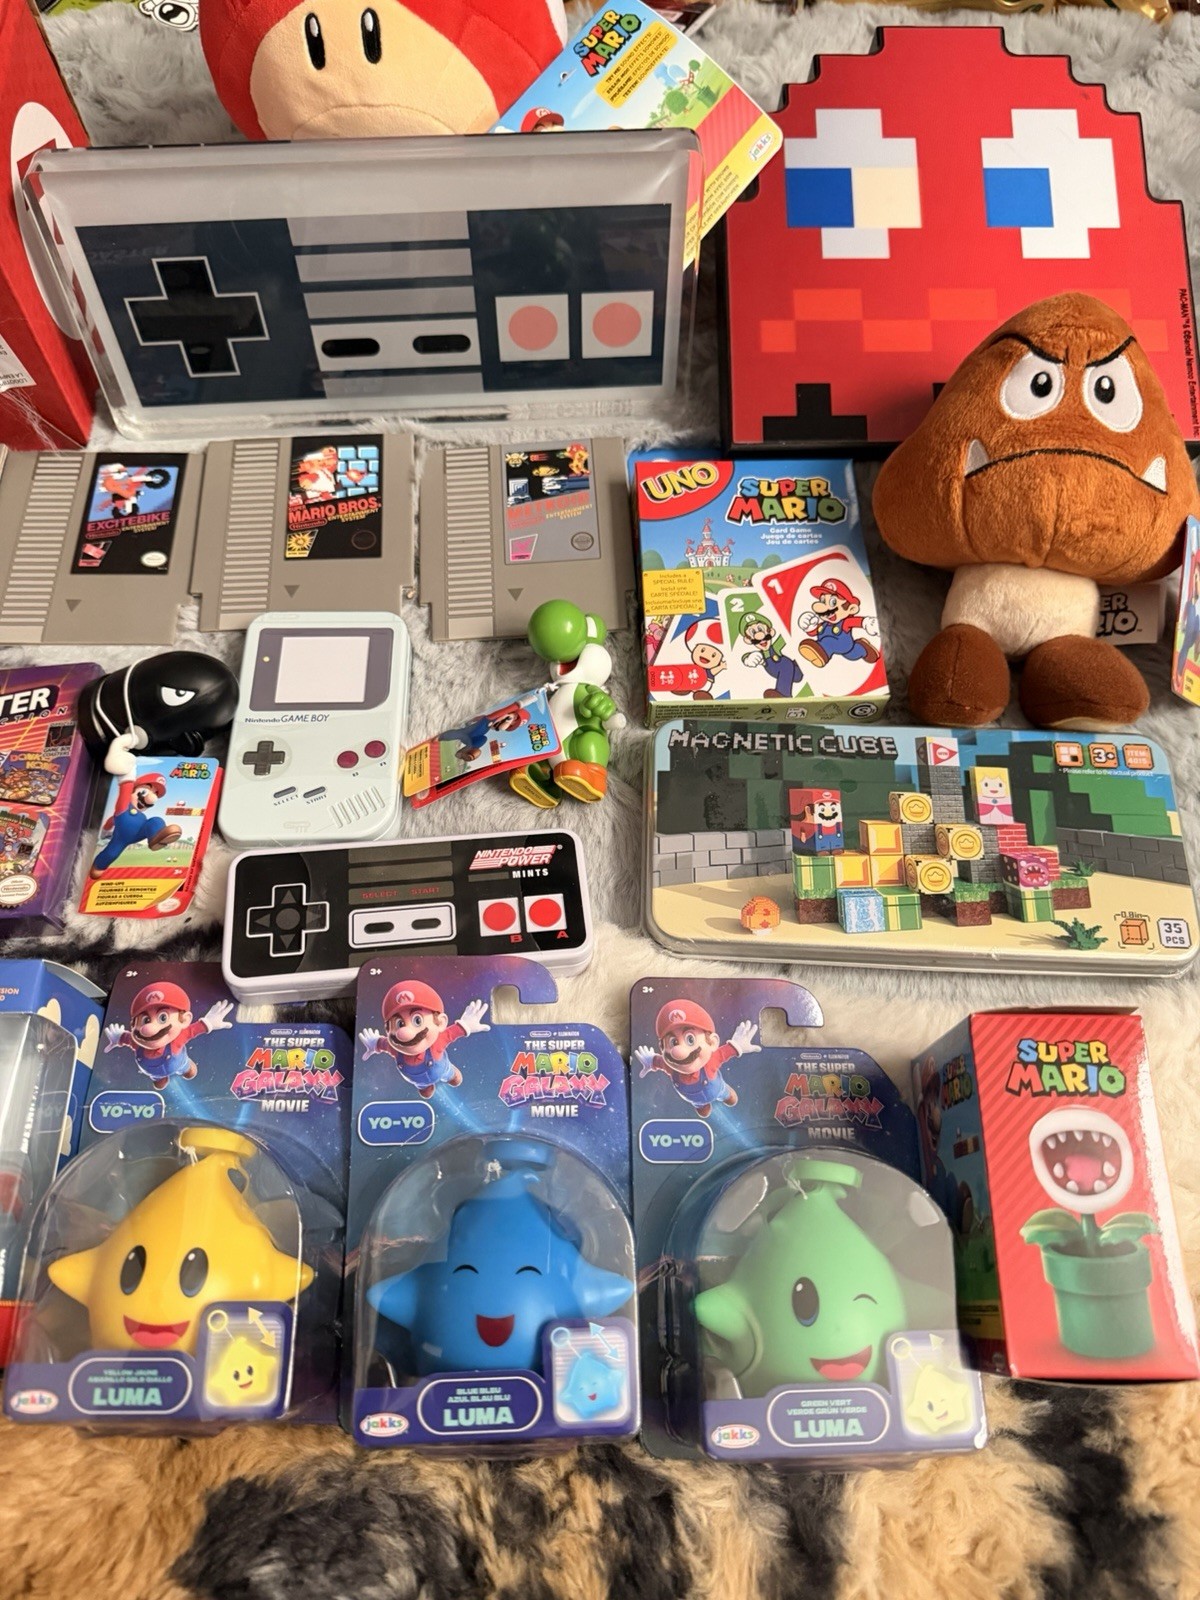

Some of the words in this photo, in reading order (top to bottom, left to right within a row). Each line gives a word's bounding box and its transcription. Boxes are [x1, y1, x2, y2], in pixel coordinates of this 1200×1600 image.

[573, 10, 621, 57] SUPER
[581, 14, 642, 77] MARIO
[751, 135, 771, 160] jakks
[1186, 358, 1194, 380] Namco
[1188, 381, 1199, 425] Entertainment
[642, 462, 719, 502] UNO
[738, 477, 831, 498] SUPER
[289, 505, 336, 523] MARIO
[338, 497, 381, 514] BROS.
[328, 508, 379, 521] ENTERTAINMENT
[546, 504, 593, 519] ENTERTAINMENT
[728, 496, 846, 524] MARIO
[87, 512, 170, 532] EXCITEBIKE
[768, 578, 784, 595] 1
[729, 598, 745, 612] 2
[0, 688, 51, 717] TER
[281, 714, 308, 722] GAME
[311, 714, 329, 722] BOY
[528, 724, 543, 752] MARIO
[540, 724, 550, 746] SUPER
[669, 730, 813, 754] MAGNETIC
[819, 735, 898, 759] CUBE
[170, 768, 211, 779] MARIO
[177, 762, 209, 770] SUPER
[274, 795, 299, 806] SELECT
[306, 794, 328, 805] START
[475, 847, 533, 859] NINTENDO
[499, 854, 553, 867] POWER
[512, 868, 549, 879] MINTS
[362, 890, 398, 899] SELECT
[410, 887, 440, 896] START
[557, 931, 569, 939] A
[1164, 923, 1183, 933] 35
[510, 934, 522, 943] B
[1165, 936, 1185, 944] PCS
[264, 1038, 286, 1047] THE
[287, 1038, 325, 1047] SUPER
[524, 1040, 546, 1050] THE
[548, 1040, 585, 1050] SUPER
[1017, 1037, 1111, 1064] SUPER
[246, 1047, 336, 1070] MARIO
[511, 1052, 599, 1075] MARIO
[796, 1062, 817, 1072] THE
[819, 1062, 855, 1073] SUPER
[230, 1069, 345, 1101] GALAXY
[784, 1073, 870, 1097] MARIO
[1005, 1062, 1127, 1098] MARIO
[499, 1074, 611, 1107] GALAXY
[100, 1105, 155, 1118] YO-YO
[261, 1100, 309, 1112] MOVIE
[531, 1105, 579, 1118] MOVIE
[774, 1095, 884, 1128] GALAXY
[369, 1116, 425, 1129] YO-YO
[649, 1134, 704, 1147] YO-YO
[808, 1127, 855, 1140] MOVIE
[15, 1391, 52, 1408] jakks
[93, 1388, 162, 1406] LUMA
[443, 1406, 514, 1427] LUMA
[815, 1406, 839, 1414] GRÜN
[366, 1416, 403, 1431] jakks
[794, 1418, 864, 1439] LUMA
[716, 1426, 754, 1443] jakks
